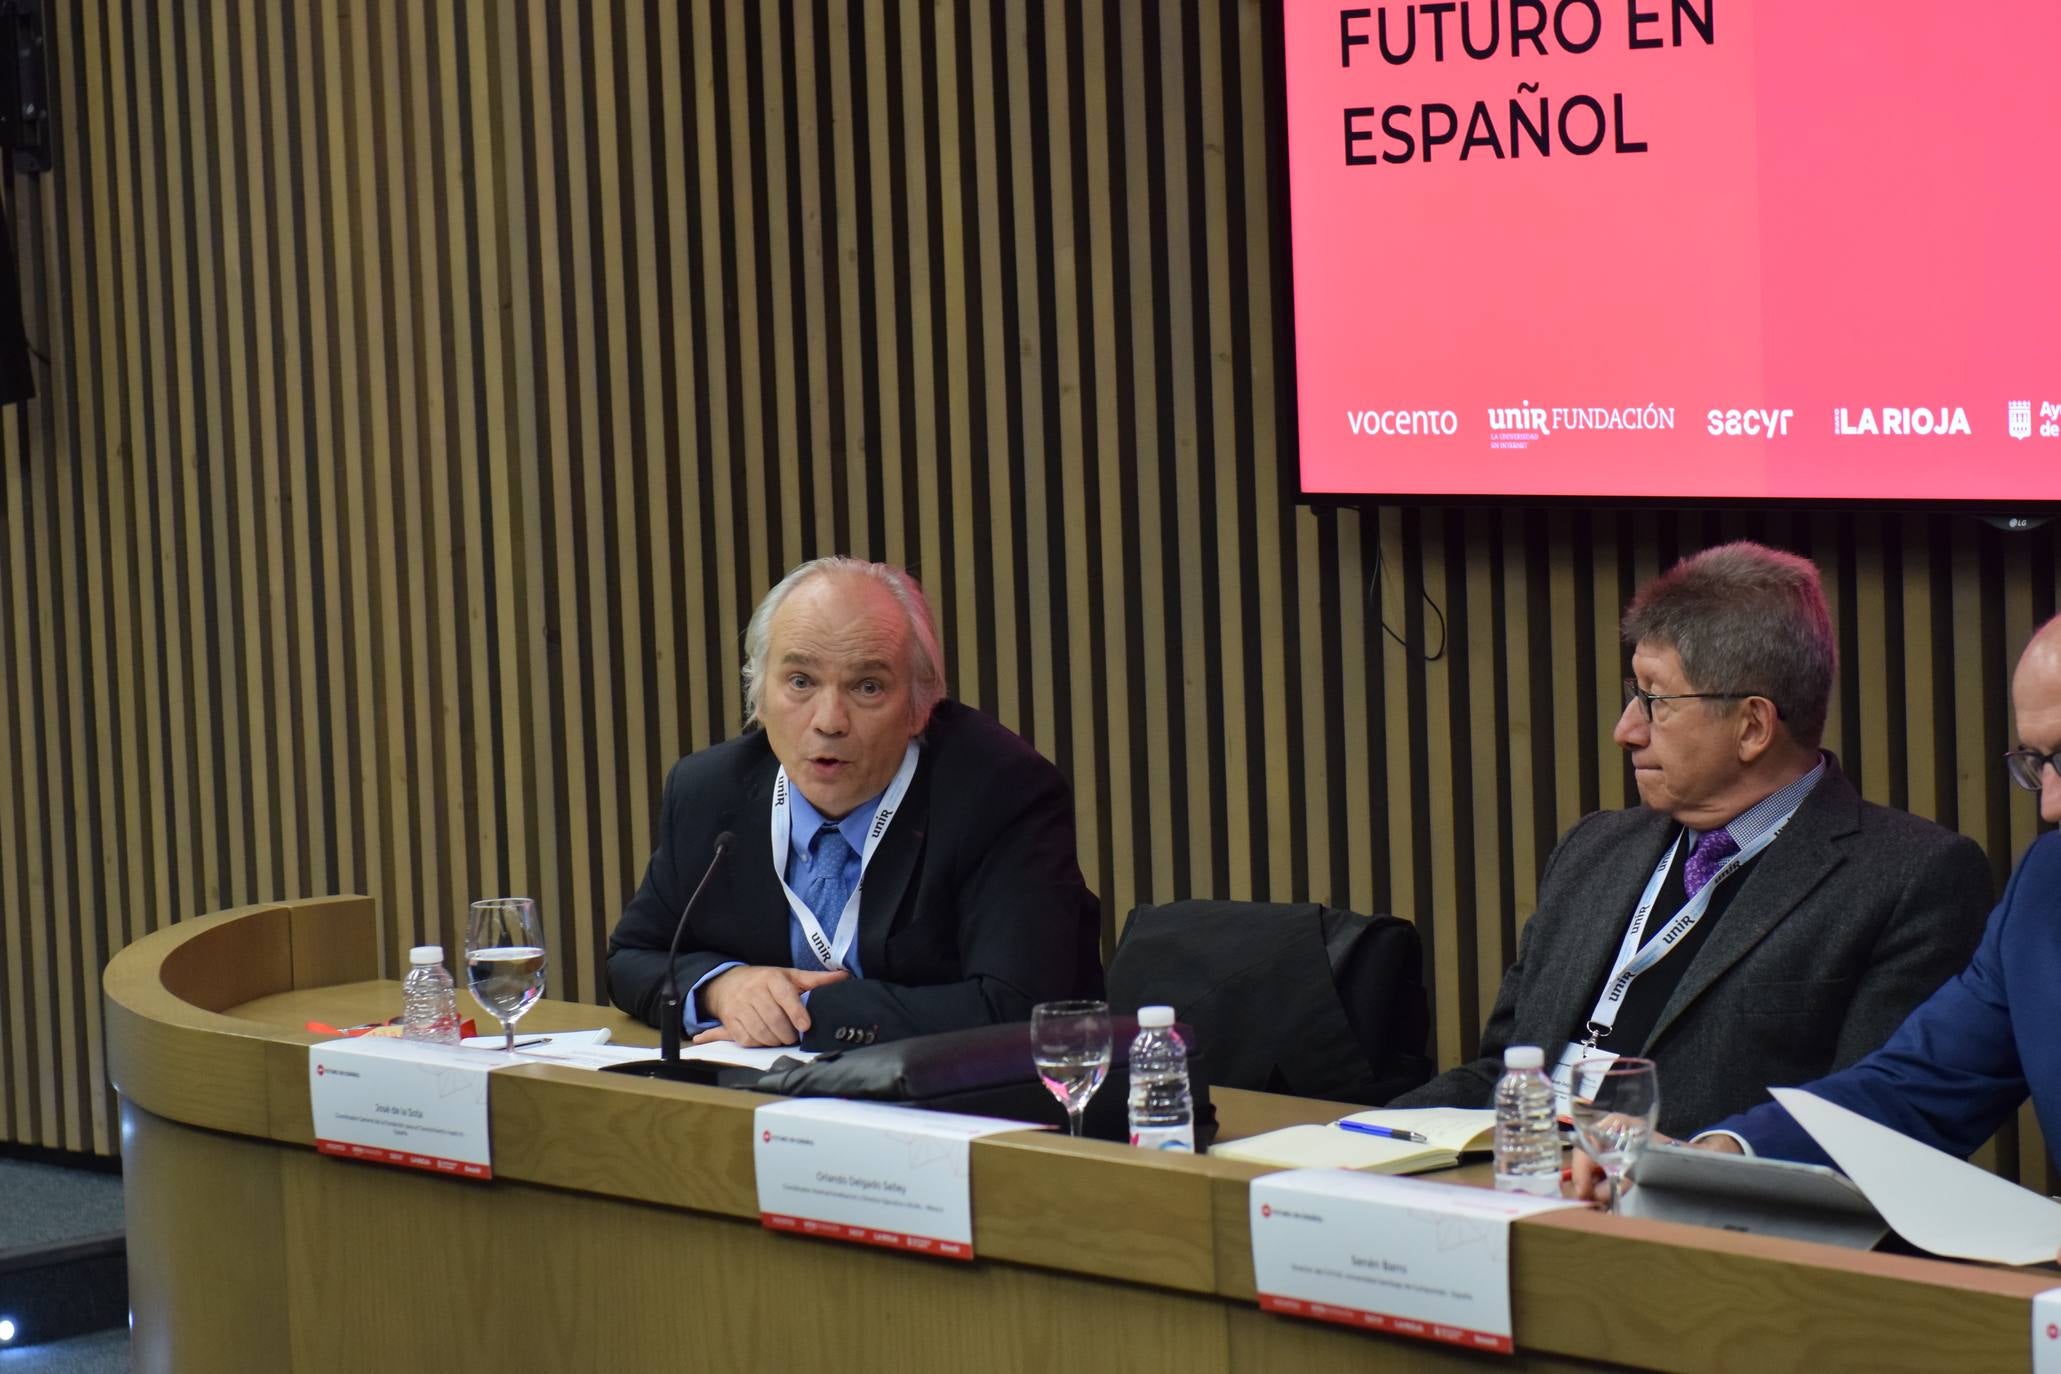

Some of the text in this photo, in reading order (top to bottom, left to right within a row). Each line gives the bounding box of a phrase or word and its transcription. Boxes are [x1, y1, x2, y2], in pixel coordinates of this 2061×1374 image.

[1340, 0, 1714, 67] FUTURO EN
[1343, 82, 1648, 166] ESPAÑOL
[1347, 409, 1458, 435] vocento
[1552, 402, 1675, 430] FUNDACIÓN
[1706, 408, 1794, 439] sacyr
[1840, 407, 1880, 435] LA
[1882, 407, 1972, 435] RIOJA
[2040, 419, 2060, 437] de
